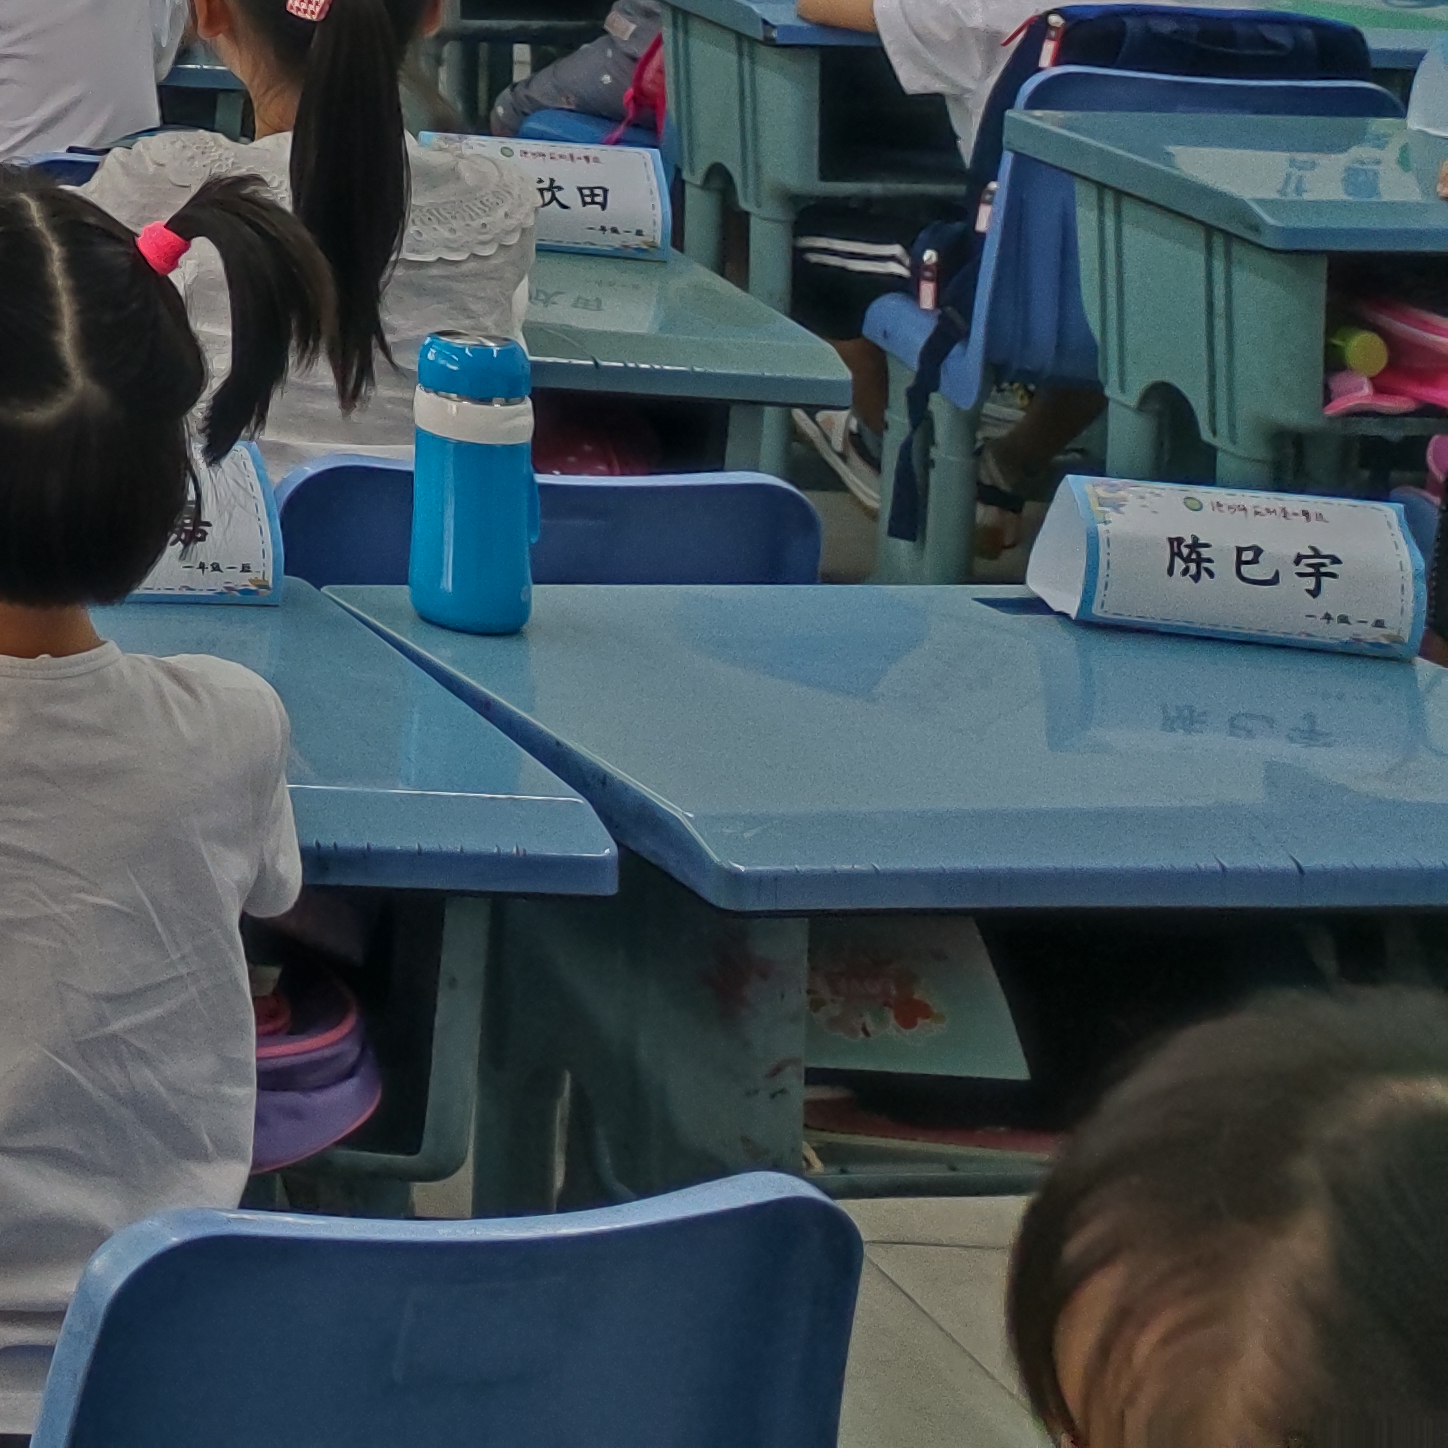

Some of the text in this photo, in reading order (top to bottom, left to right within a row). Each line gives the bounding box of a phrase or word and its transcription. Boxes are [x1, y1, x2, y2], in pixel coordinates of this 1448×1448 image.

[182, 561, 252, 575] 一年级一班
